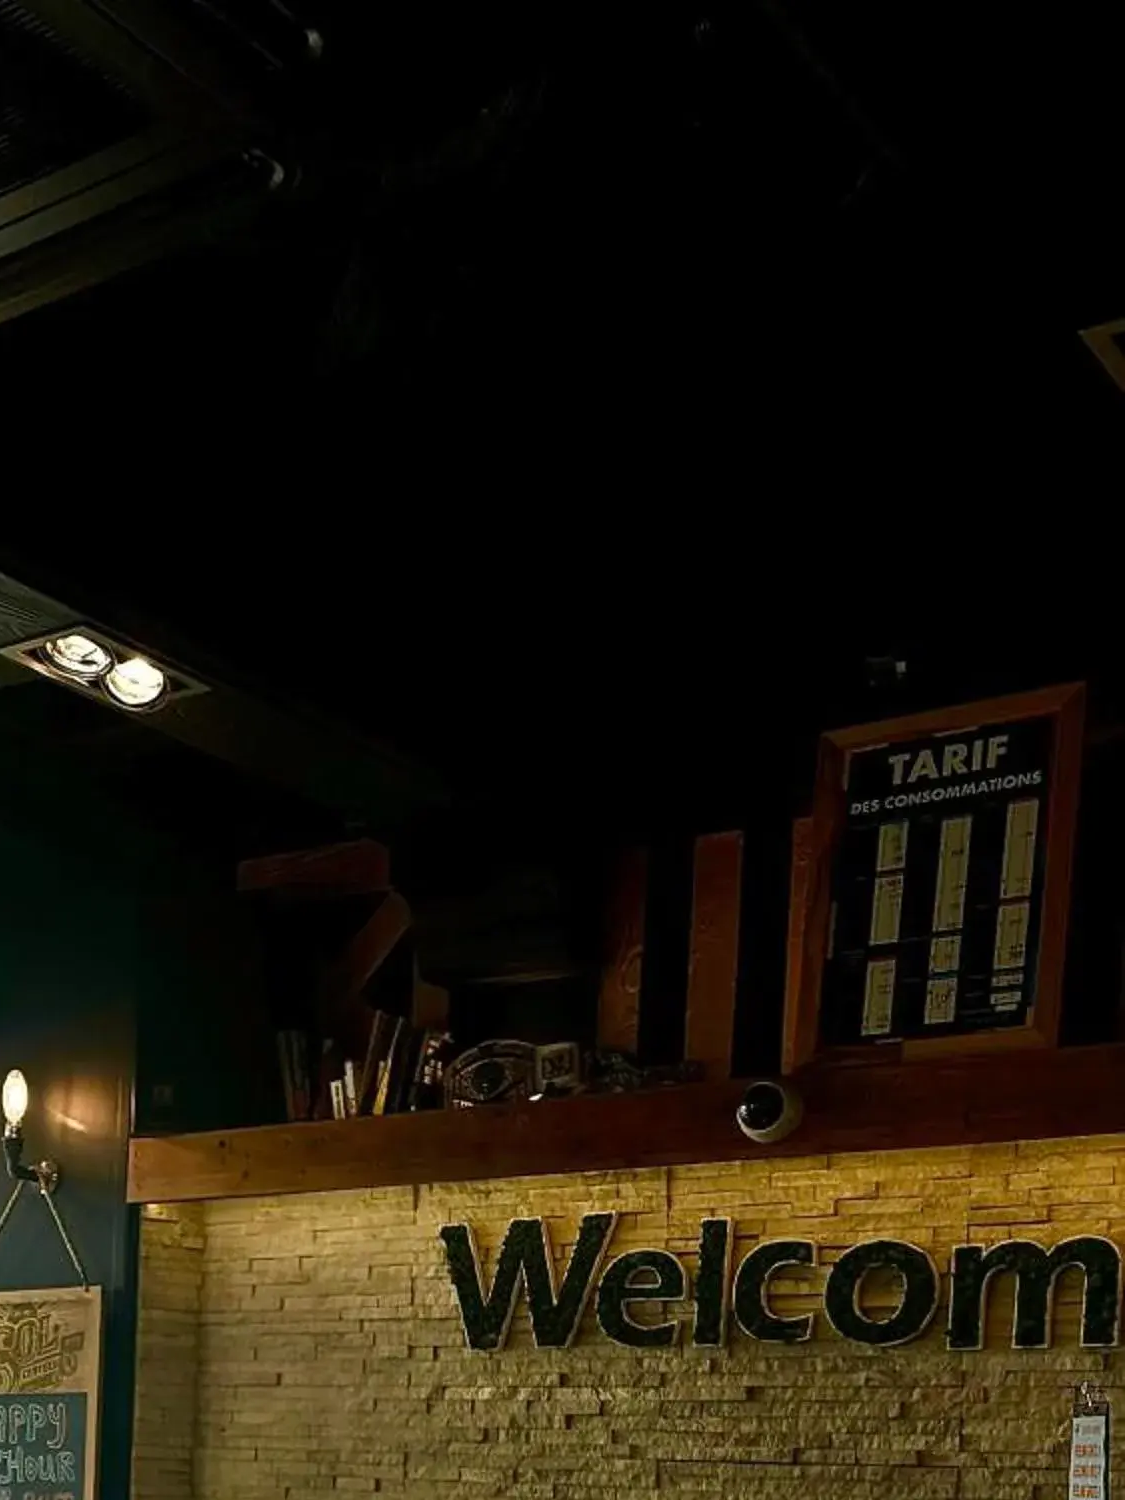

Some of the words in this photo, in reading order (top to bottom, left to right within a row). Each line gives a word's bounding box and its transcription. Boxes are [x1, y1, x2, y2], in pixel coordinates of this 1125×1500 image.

[887, 733, 1010, 786] TARIF
[848, 799, 880, 816] DES
[883, 768, 1044, 810] CONSOMMATIONS
[437, 1210, 1123, 1351] Welcom
